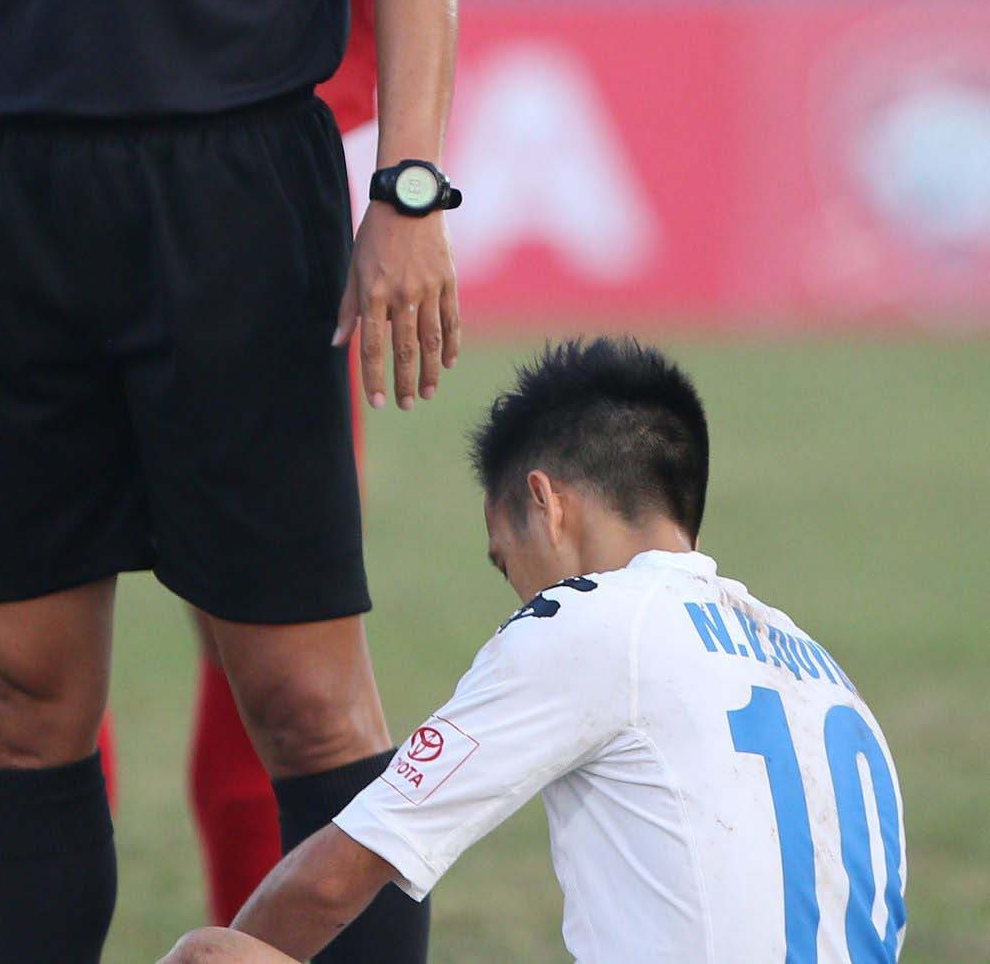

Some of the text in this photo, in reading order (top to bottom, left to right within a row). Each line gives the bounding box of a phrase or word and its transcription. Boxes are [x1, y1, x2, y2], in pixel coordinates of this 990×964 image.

[684, 602, 856, 694] N.V.QUY
[392, 756, 424, 788] YOTA
[726, 685, 906, 964] 10
